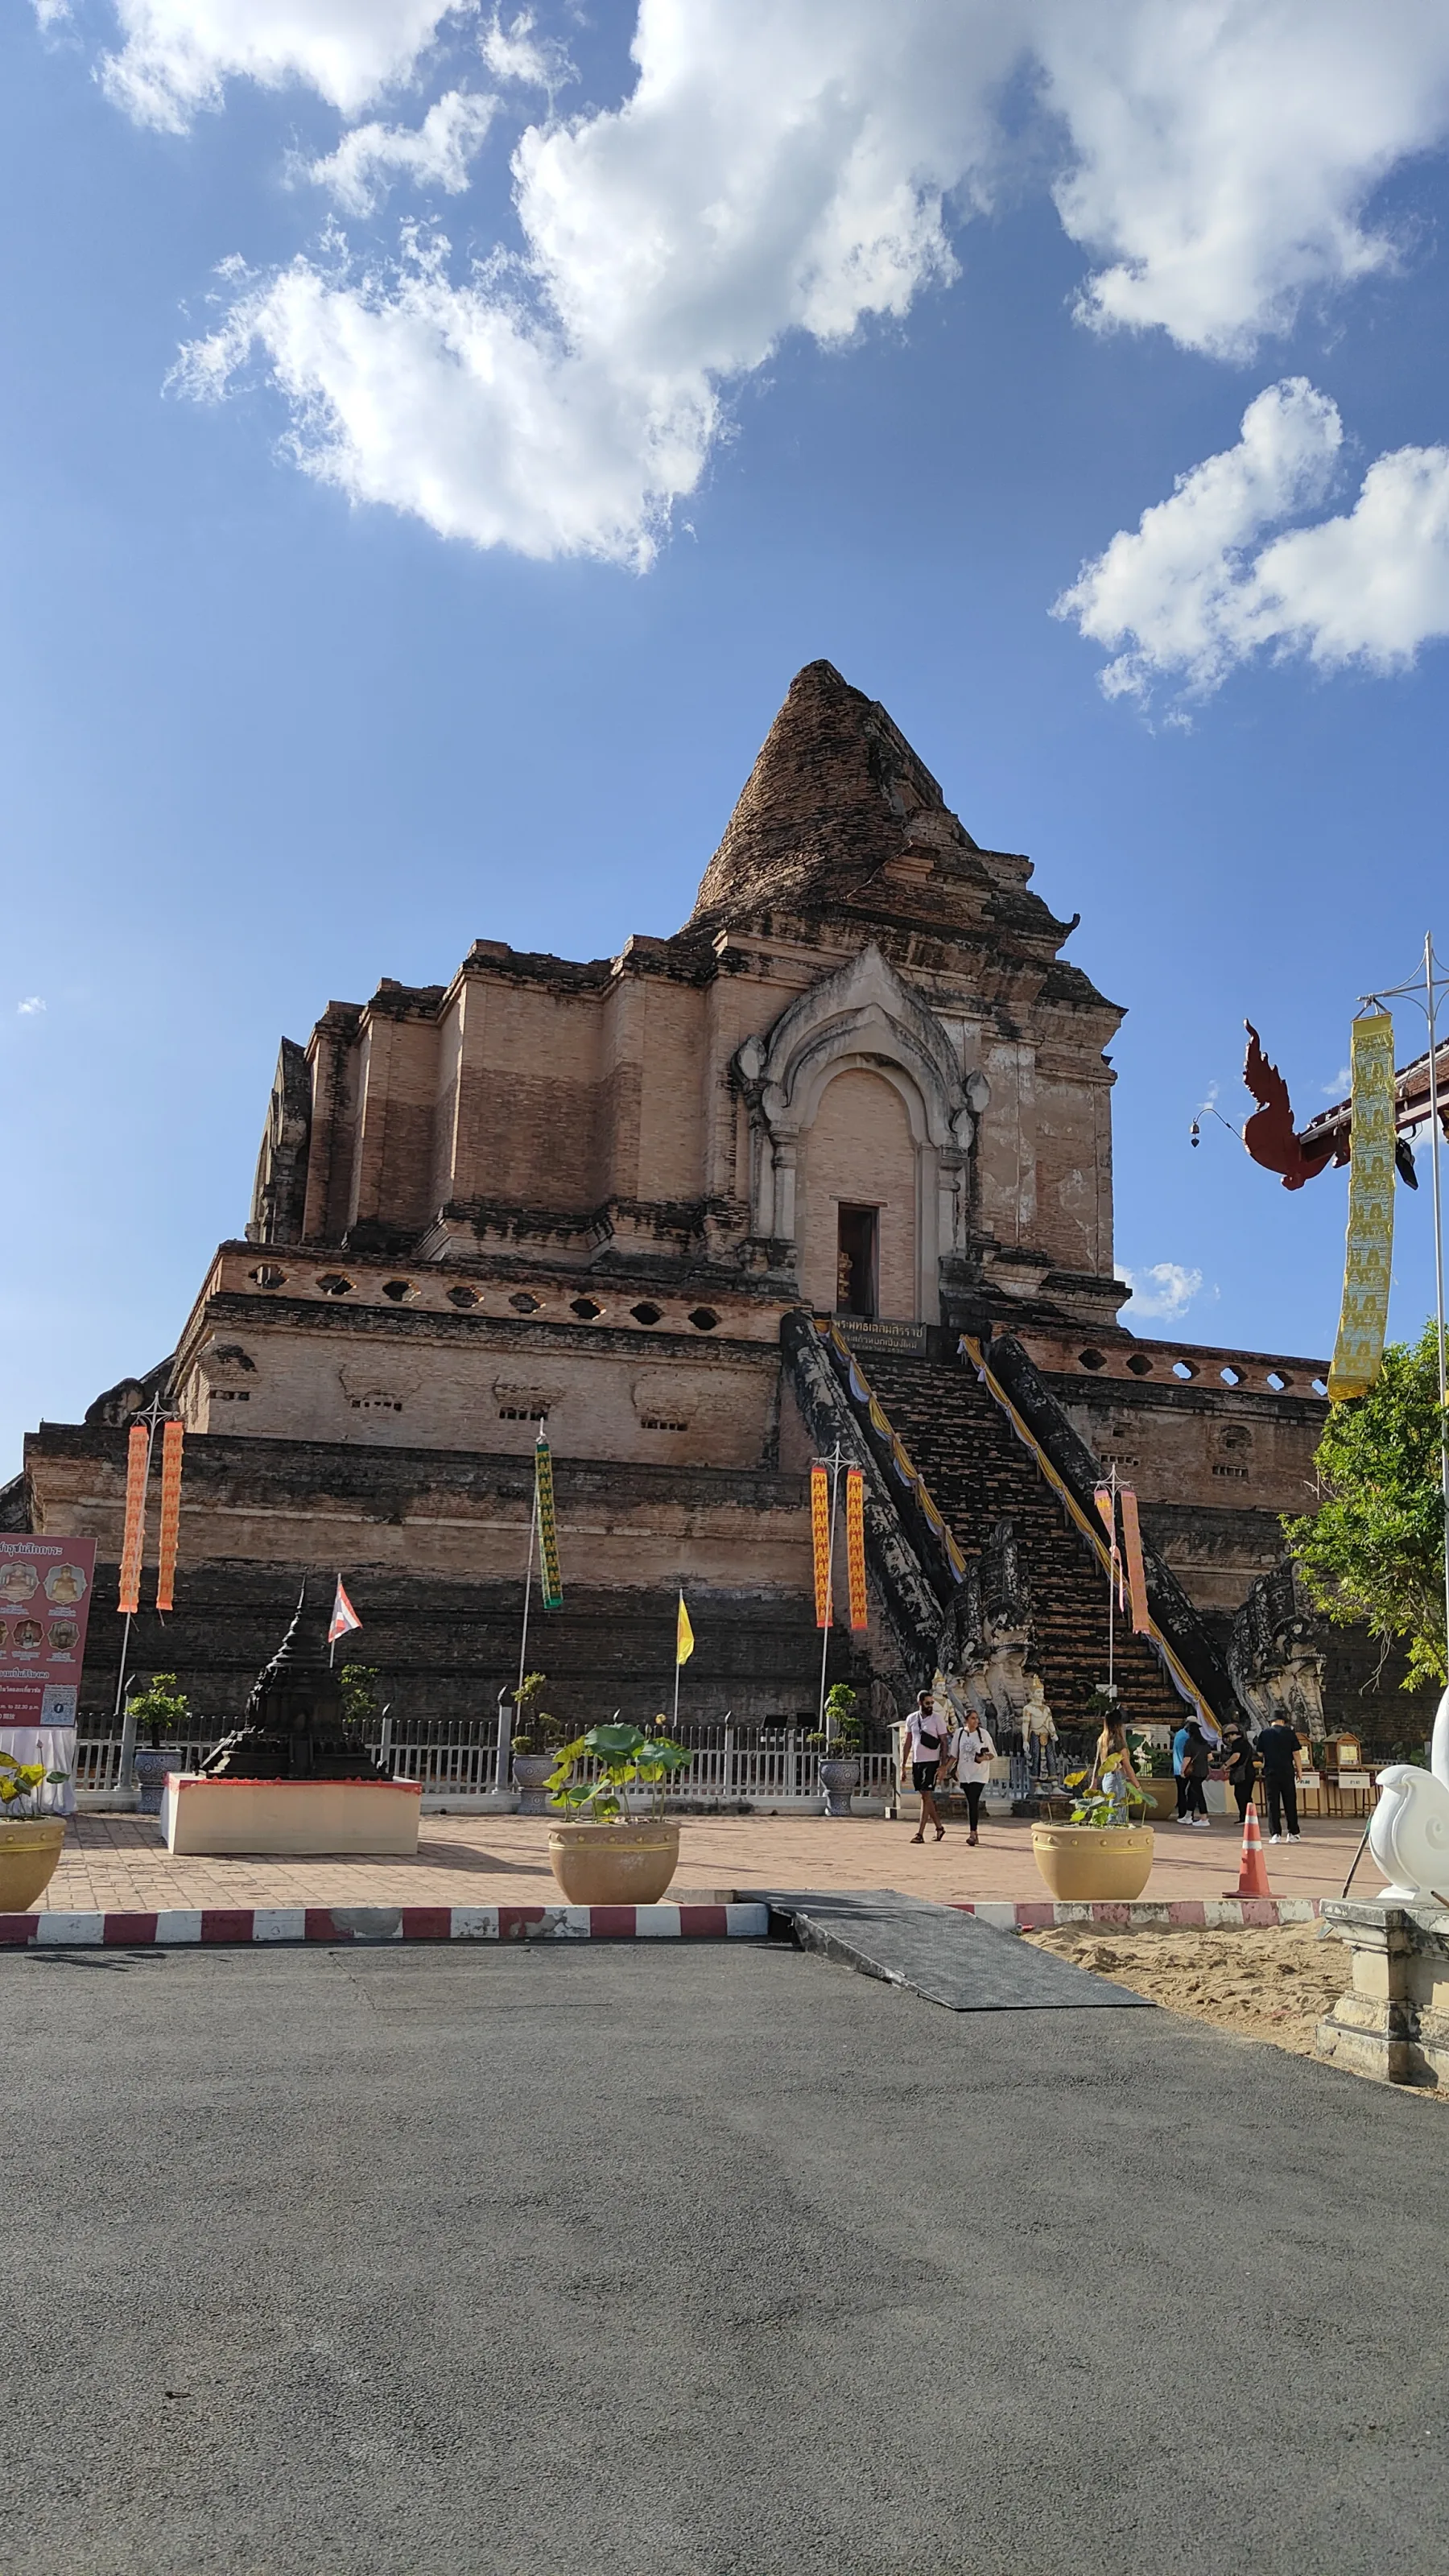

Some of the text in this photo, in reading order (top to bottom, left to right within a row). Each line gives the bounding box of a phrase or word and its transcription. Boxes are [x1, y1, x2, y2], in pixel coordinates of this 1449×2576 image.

[843, 1335, 918, 1350] ระแก้วหยกเชียงใหม่
